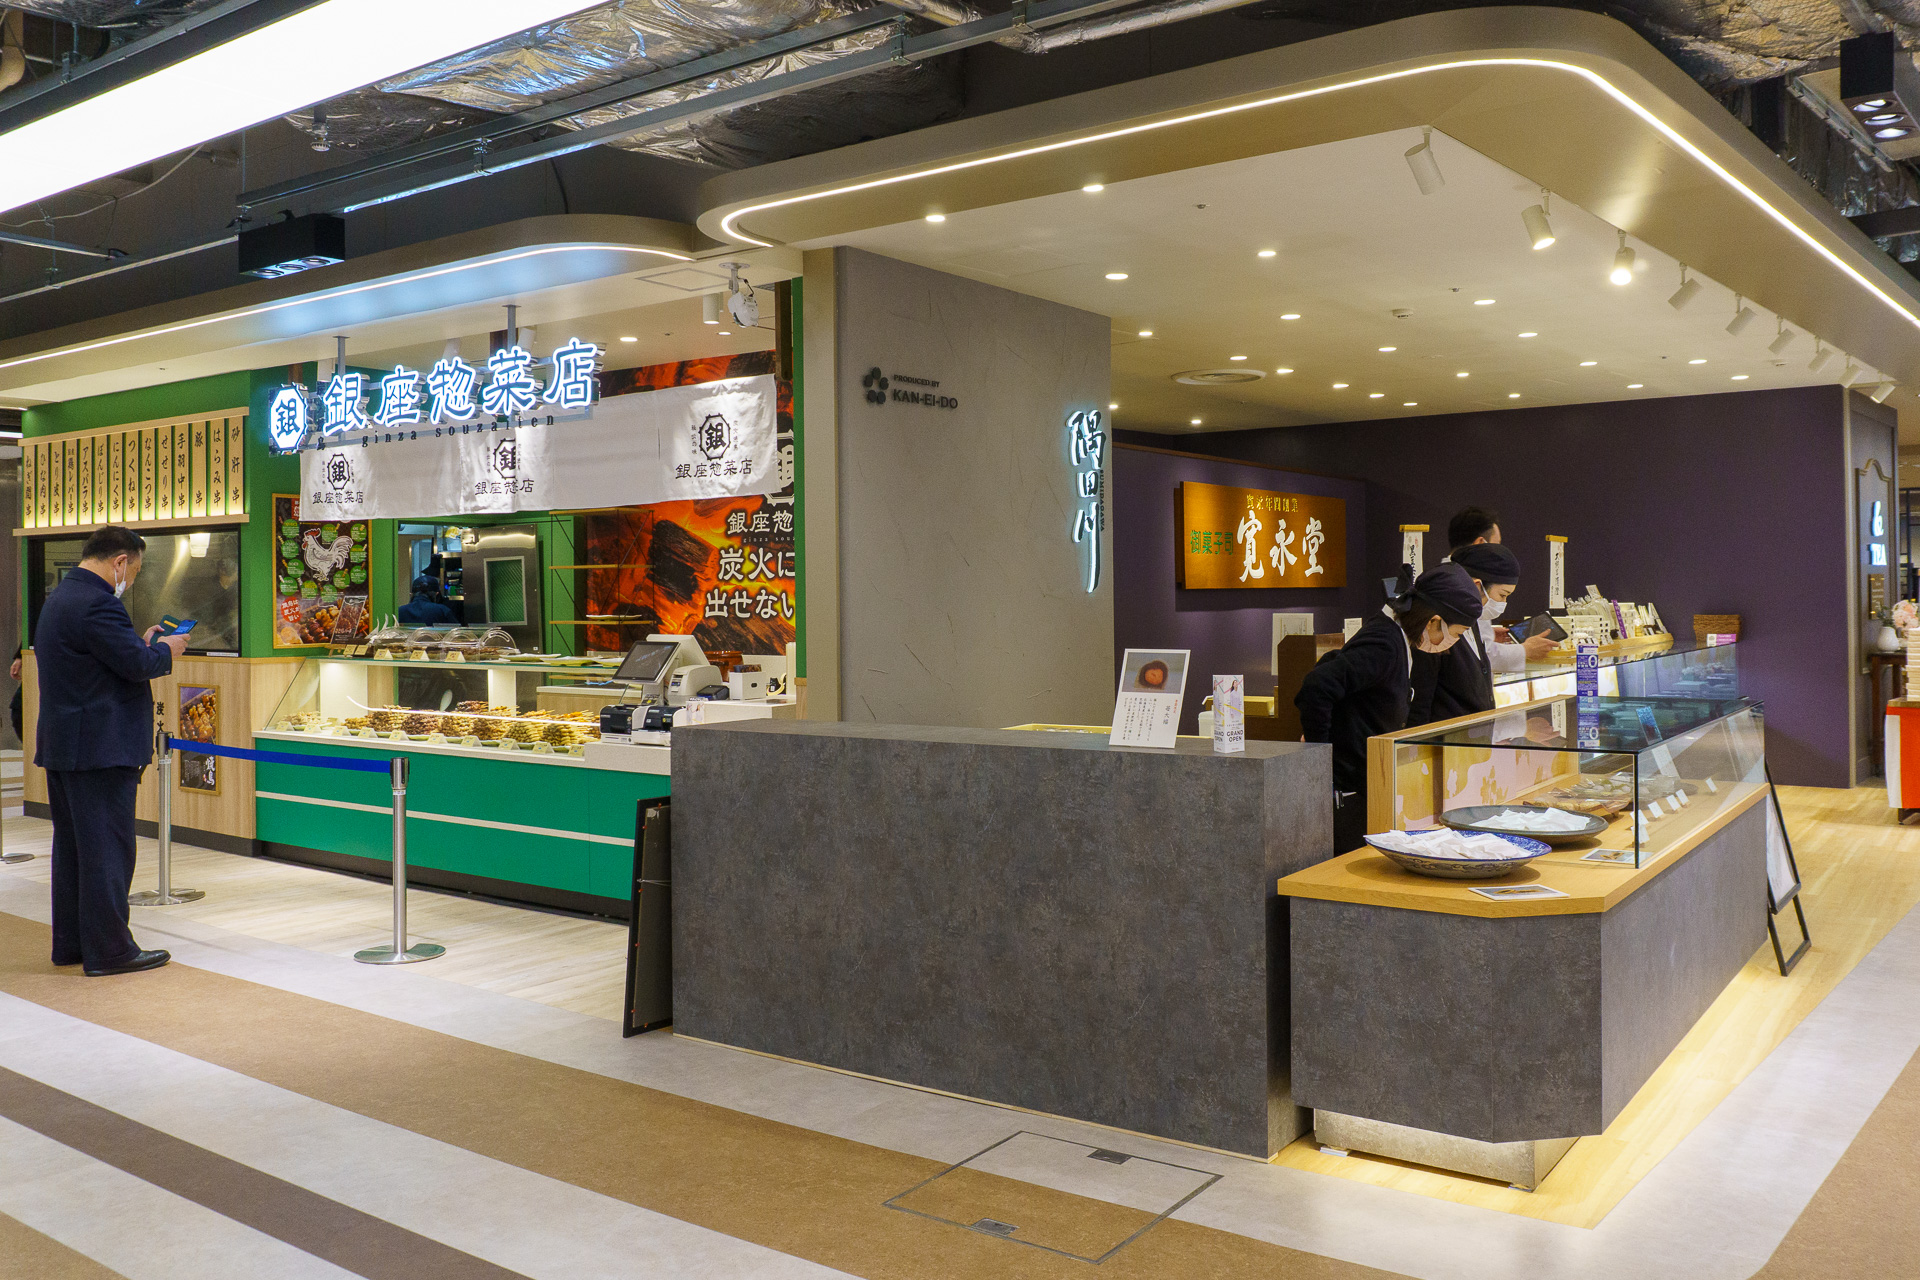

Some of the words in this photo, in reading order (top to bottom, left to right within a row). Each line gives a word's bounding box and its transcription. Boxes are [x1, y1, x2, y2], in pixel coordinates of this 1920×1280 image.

[322, 337, 598, 436] 銀座惣菜店
[893, 374, 930, 386] PRODUCED
[274, 396, 298, 437] 銀
[893, 389, 958, 410] KAN-EI-DO
[362, 429, 418, 448] ginza
[434, 413, 556, 438] souzaiten
[705, 422, 727, 452] 銀
[82, 446, 90, 515] アスパラ串
[112, 441, 120, 512] にんにく串
[128, 440, 136, 511] つくね串
[144, 437, 152, 511] なんこつ串
[161, 434, 169, 510] せせり串
[177, 432, 186, 509] 手羽中串
[213, 428, 221, 506] はらみ串
[231, 426, 241, 504] 砂肝串
[331, 461, 347, 483] 銀
[675, 458, 754, 479] 銀座惣菜店
[312, 491, 364, 505] 銀座惣菜店
[1066, 409, 1107, 593] 隅田川
[727, 511, 794, 536] 銀座惣
[743, 536, 769, 544] ginza
[1190, 529, 1234, 556] 御菓子司
[1237, 510, 1325, 583] 寛永堂
[718, 547, 795, 581] 炭火に
[1226, 729, 1243, 737] GRAND
[205, 755, 216, 786] 焼鳥
